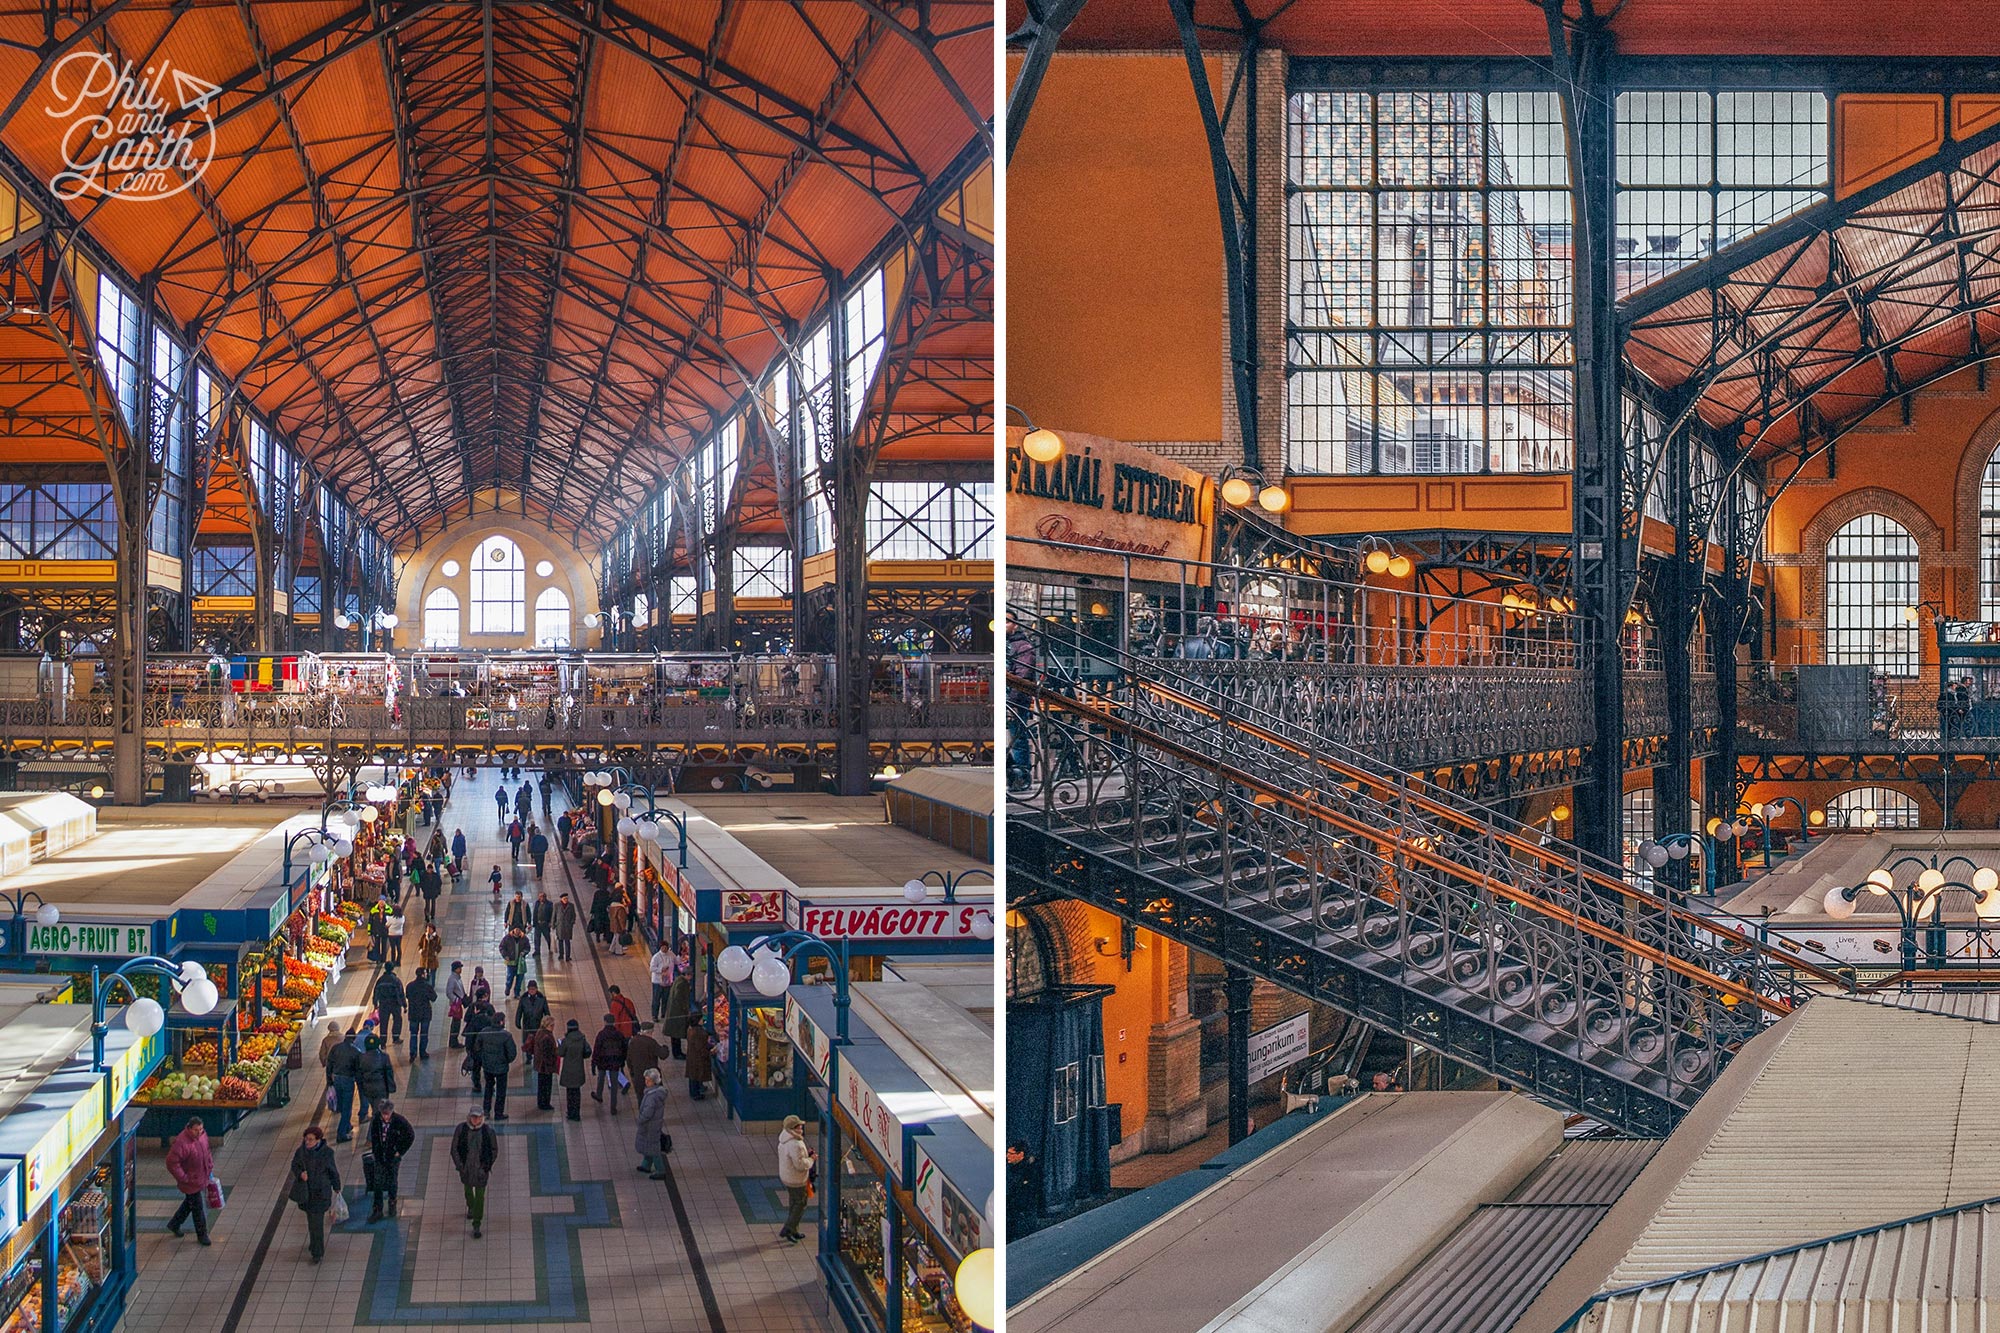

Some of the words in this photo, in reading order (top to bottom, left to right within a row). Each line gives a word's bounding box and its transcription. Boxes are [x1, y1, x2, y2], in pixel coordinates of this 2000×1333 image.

[805, 906, 949, 936] FELVÁGOTT
[30, 925, 119, 952] AGRO-FRUIT
[127, 928, 148, 954] BT.
